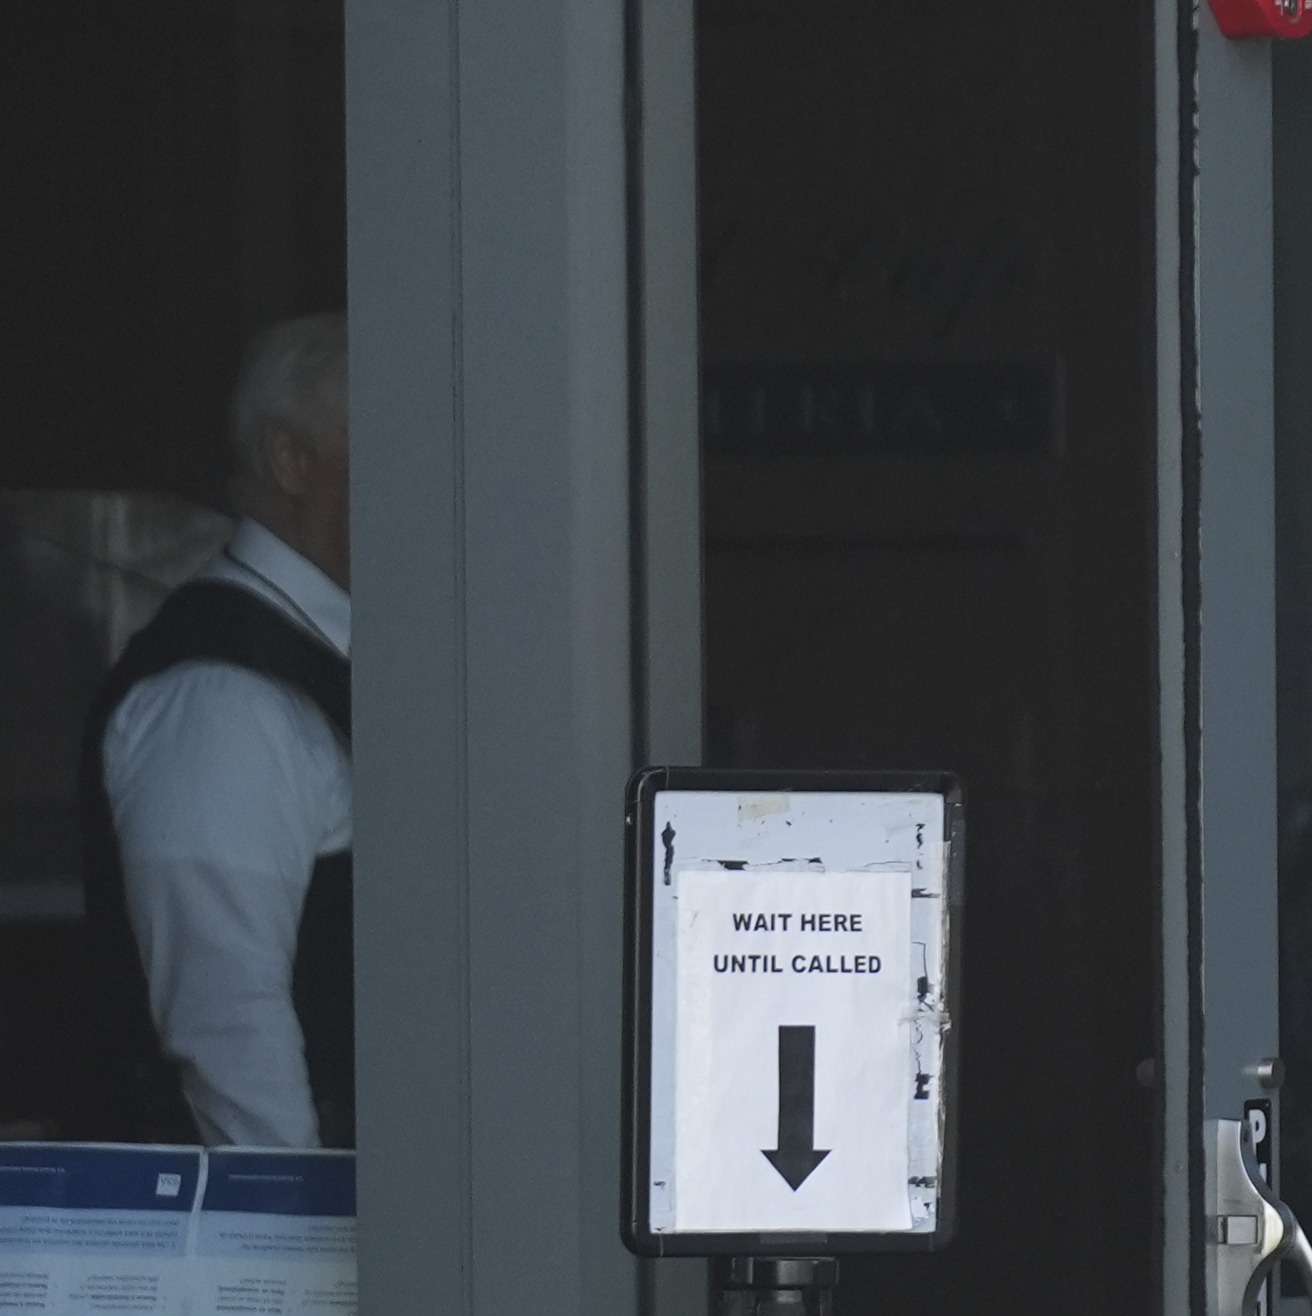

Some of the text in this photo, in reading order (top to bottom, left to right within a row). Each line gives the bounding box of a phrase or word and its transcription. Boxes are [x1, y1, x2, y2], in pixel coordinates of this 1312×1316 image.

[733, 914, 862, 932] WAIT HERE
[714, 955, 881, 973] UNTIL CALLED
